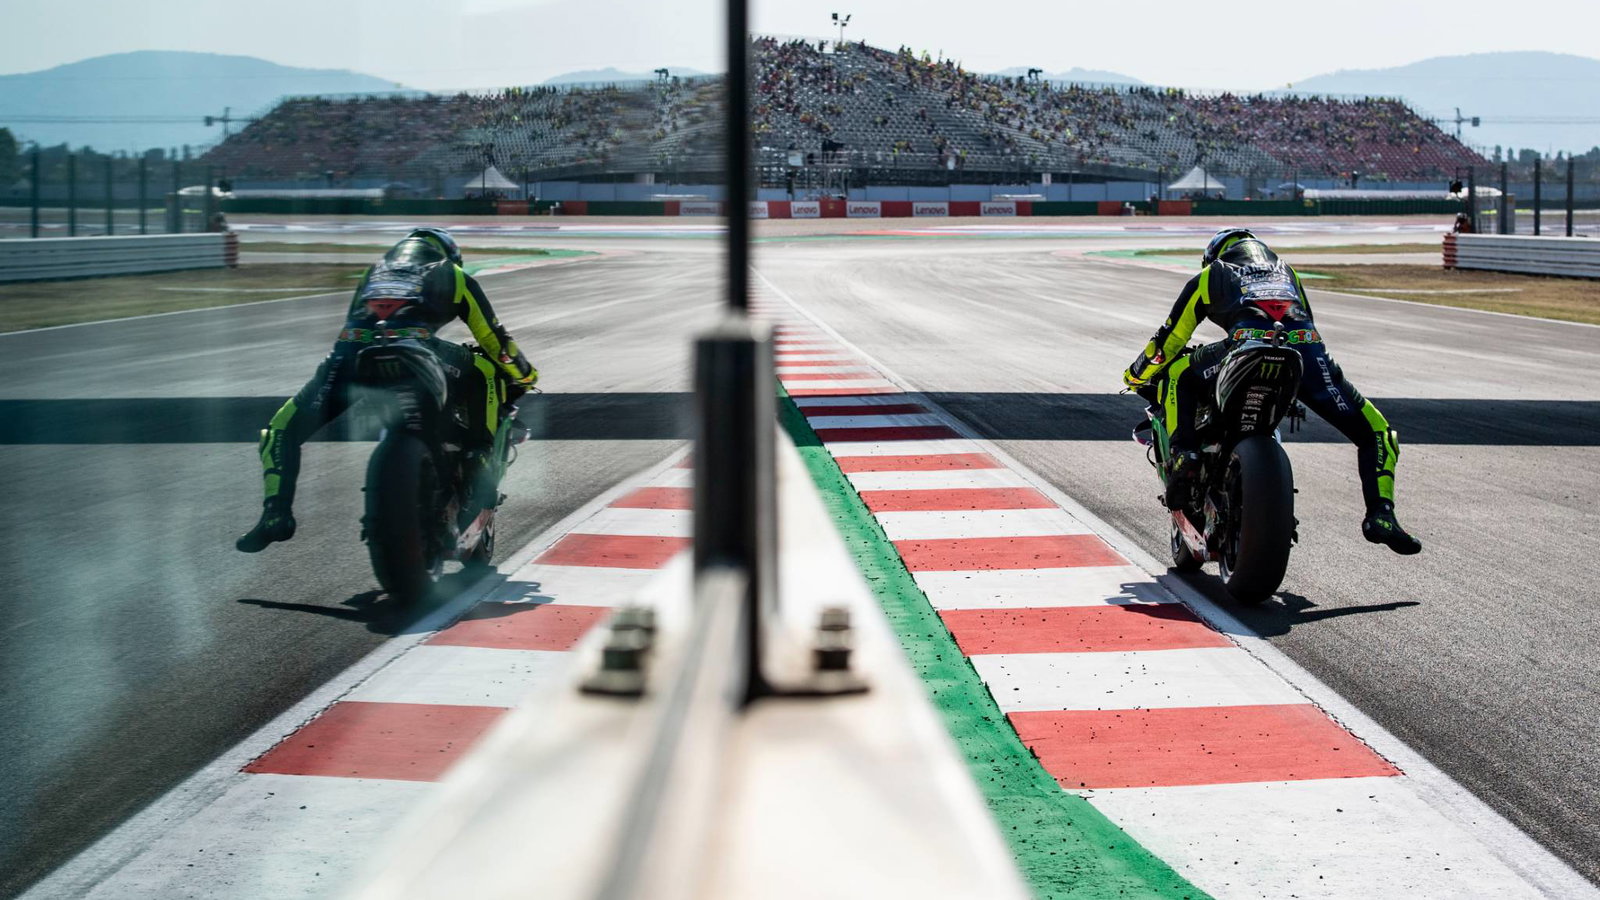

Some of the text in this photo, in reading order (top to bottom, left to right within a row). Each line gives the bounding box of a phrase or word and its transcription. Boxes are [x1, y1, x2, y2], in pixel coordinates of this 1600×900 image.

[794, 205, 818, 214] Lenovo
[848, 204, 879, 214] Lenovo
[915, 204, 946, 214] Lenovo
[983, 204, 1014, 214] Lenovo
